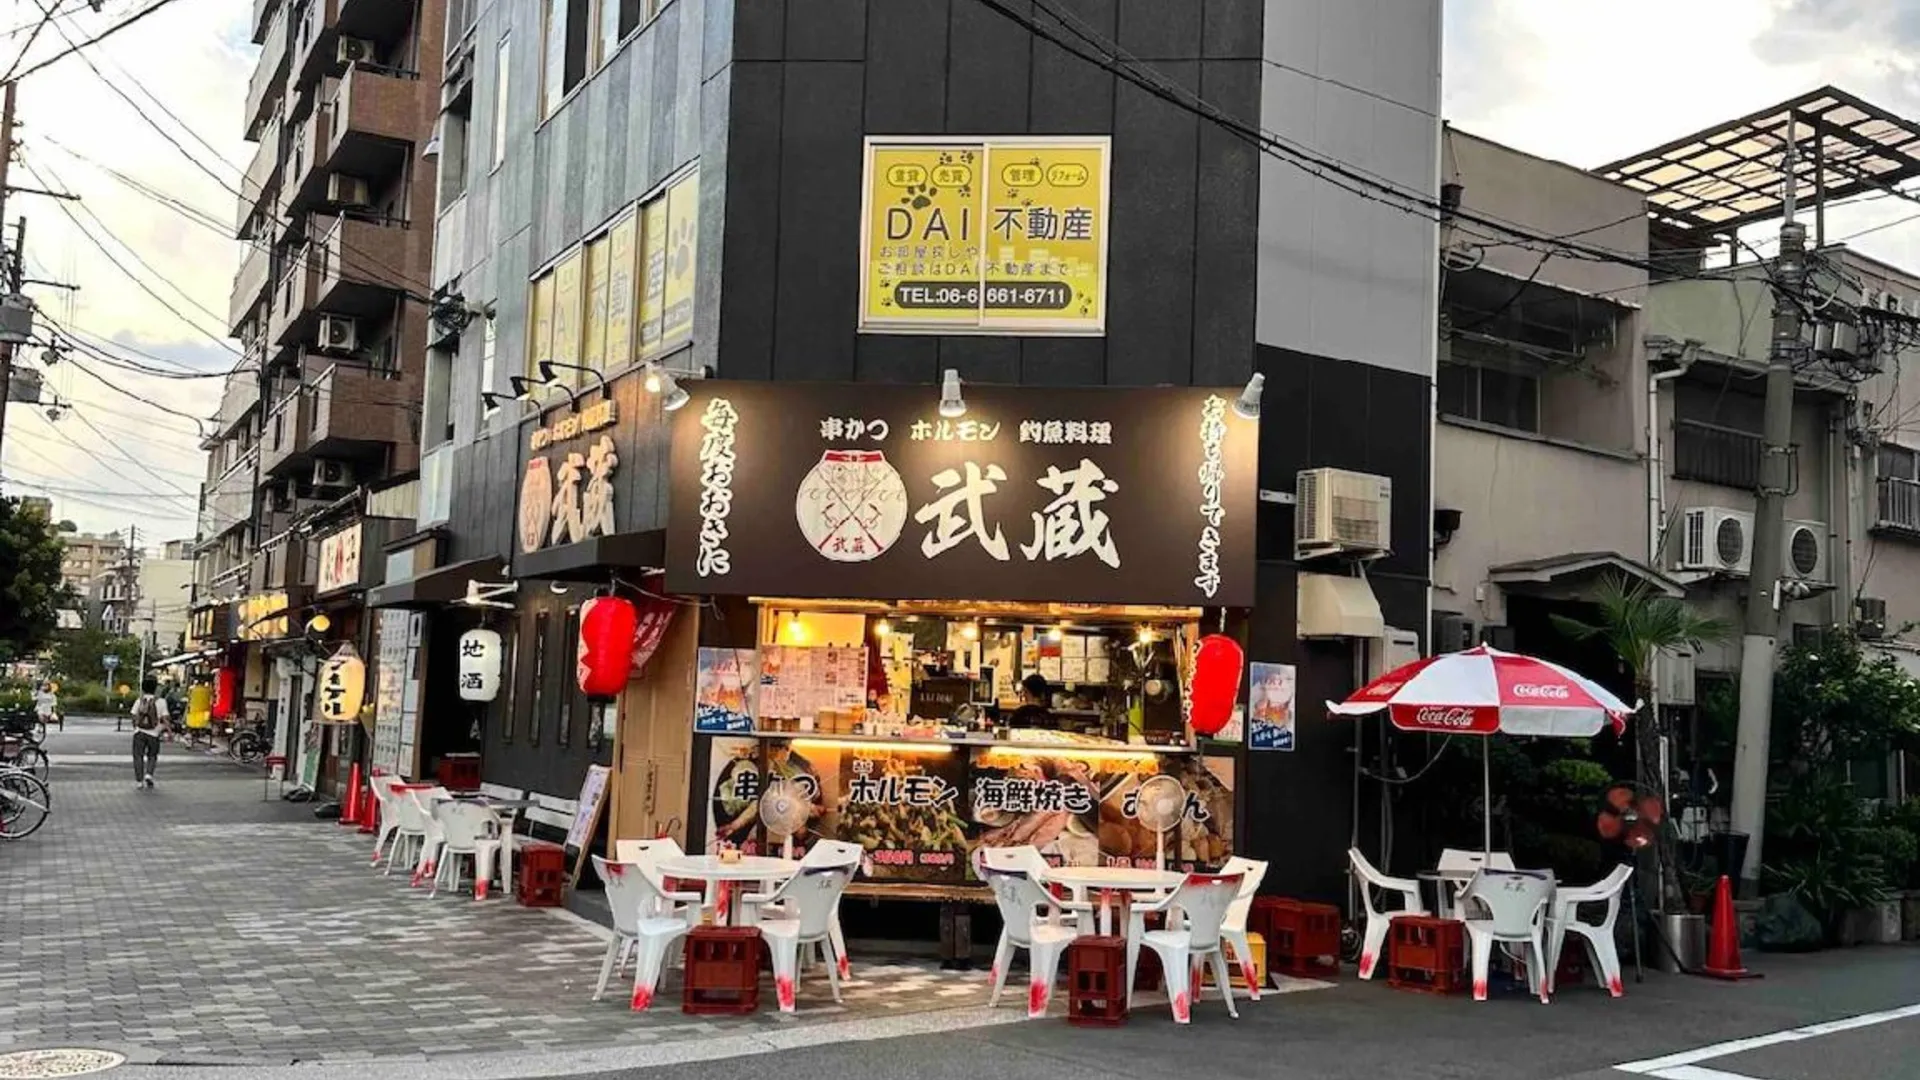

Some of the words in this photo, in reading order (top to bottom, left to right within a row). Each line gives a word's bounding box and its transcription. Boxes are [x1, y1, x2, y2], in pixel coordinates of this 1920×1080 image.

[938, 169, 965, 184] 売買
[1009, 168, 1035, 183] 管理
[886, 207, 969, 241] DAI
[993, 206, 1093, 241] 不動産
[819, 416, 889, 441] 串かつ
[910, 420, 1000, 441] ホルモン
[1019, 420, 1113, 444] 釣魚料理
[697, 397, 739, 577] 毎度おおきに
[914, 457, 1121, 569] 武蔵
[461, 639, 486, 690] 地酒
[850, 772, 959, 808] ホルモン
[974, 776, 1092, 814] 海鮮焼き
[1121, 788, 1212, 823] おん
